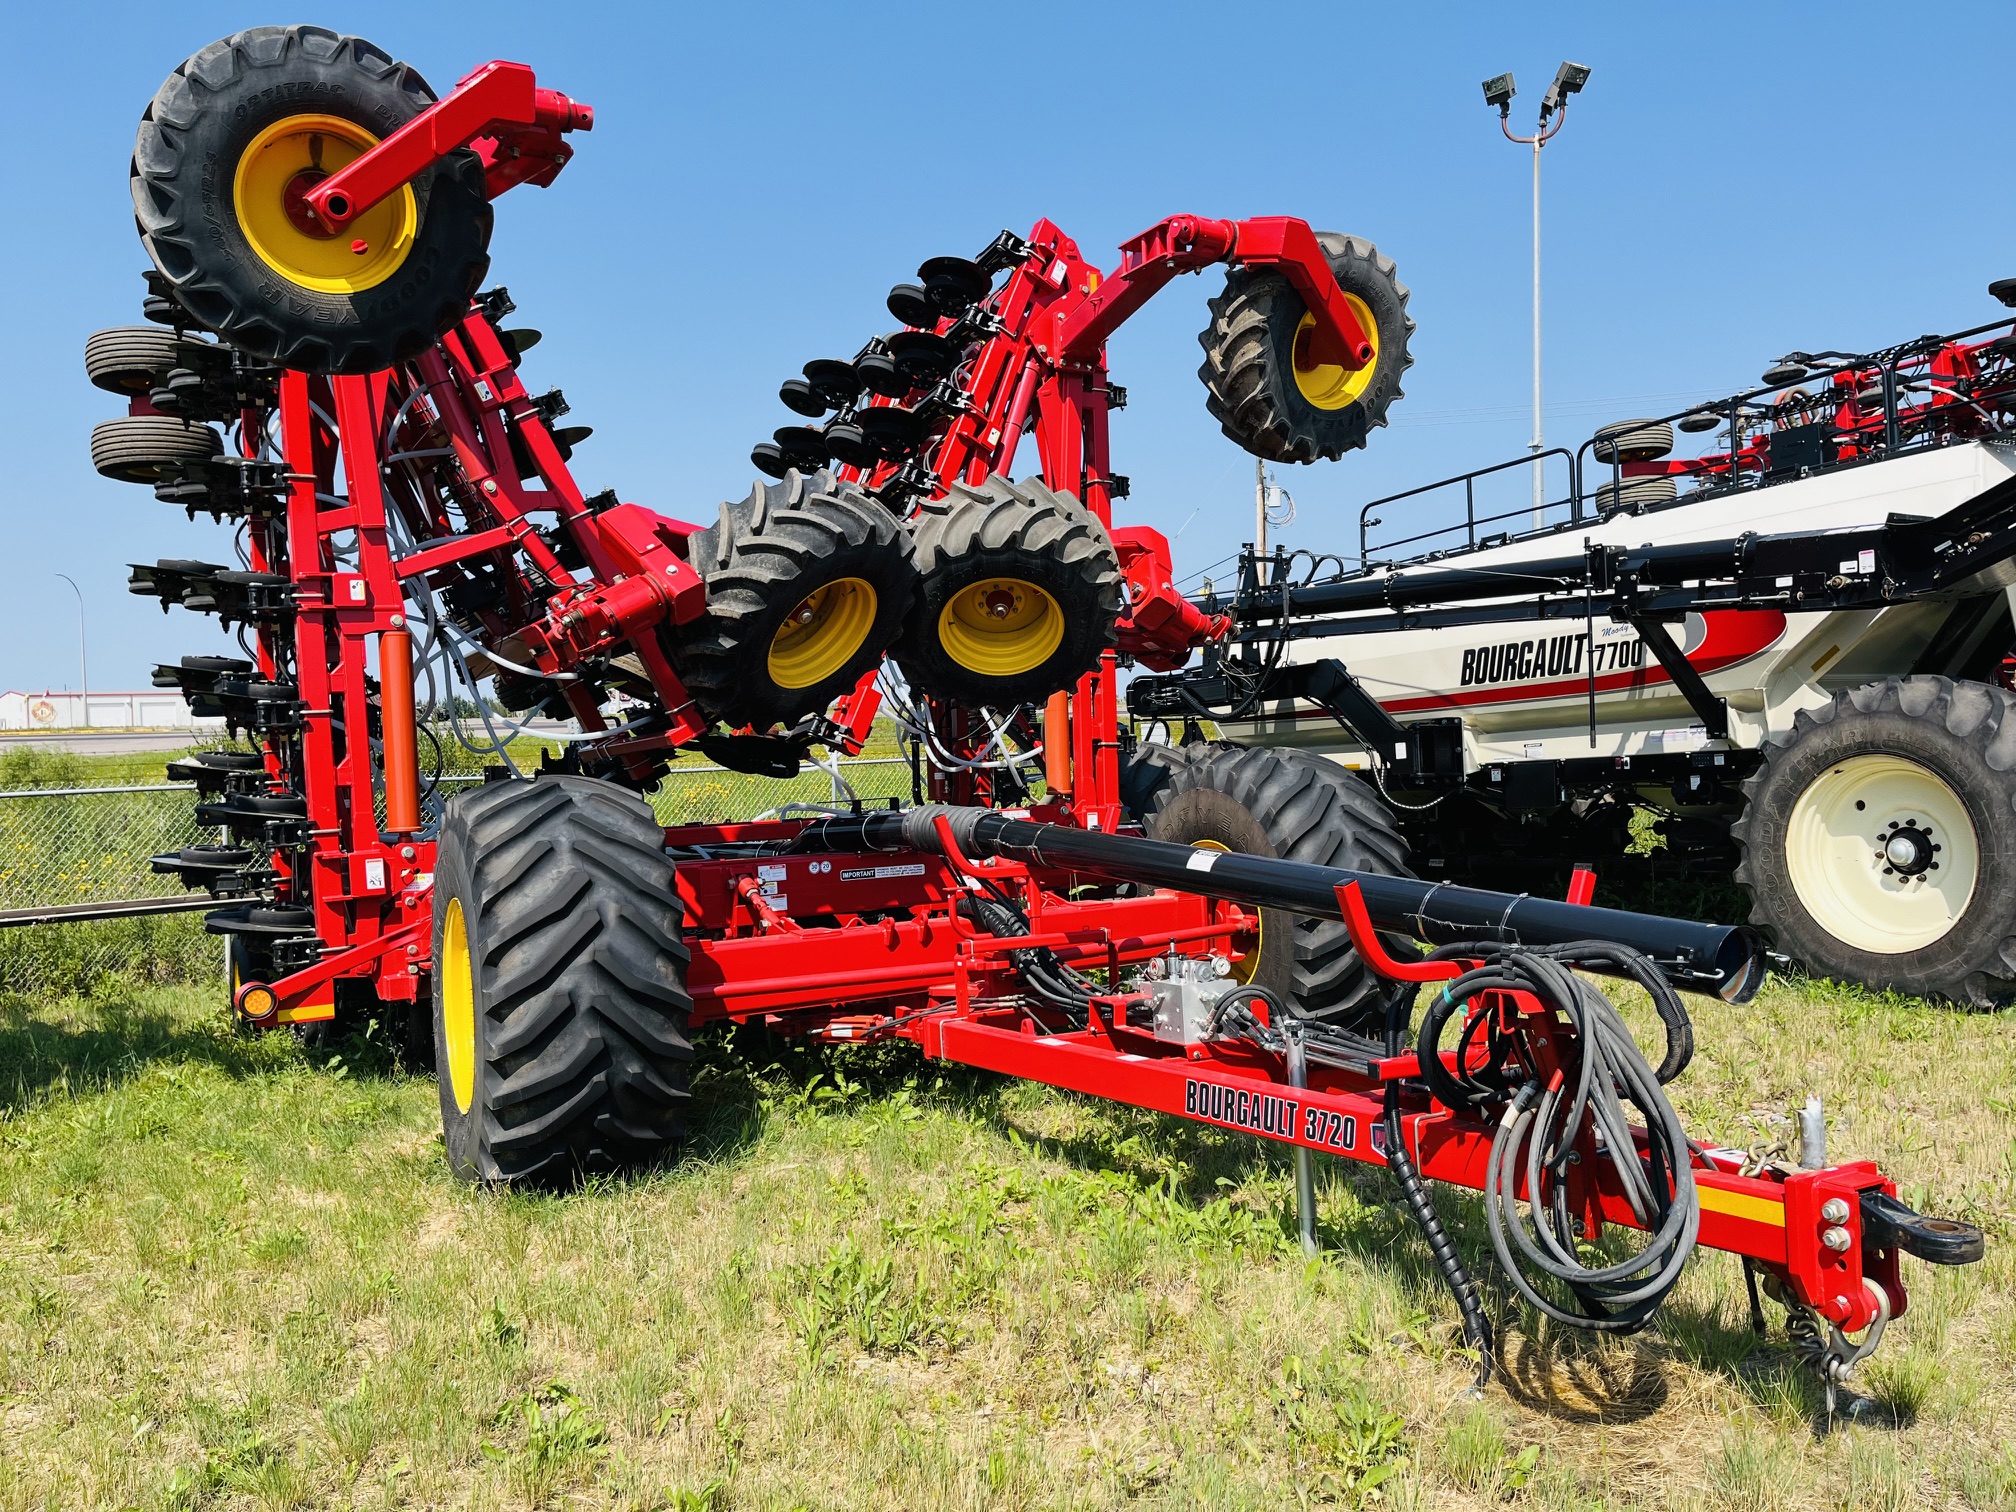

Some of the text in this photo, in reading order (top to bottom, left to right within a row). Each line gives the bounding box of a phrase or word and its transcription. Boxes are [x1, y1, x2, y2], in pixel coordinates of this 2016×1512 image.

[233, 80, 348, 122] OPTITRAC
[257, 245, 442, 326] GOODYEAR
[1460, 633, 1644, 687] BOURGAULT 7700
[1758, 727, 1866, 920] GOODYEAR
[842, 870, 875, 879] IMPORTANT
[1185, 1078, 1357, 1151] BOURGAULT 3720
